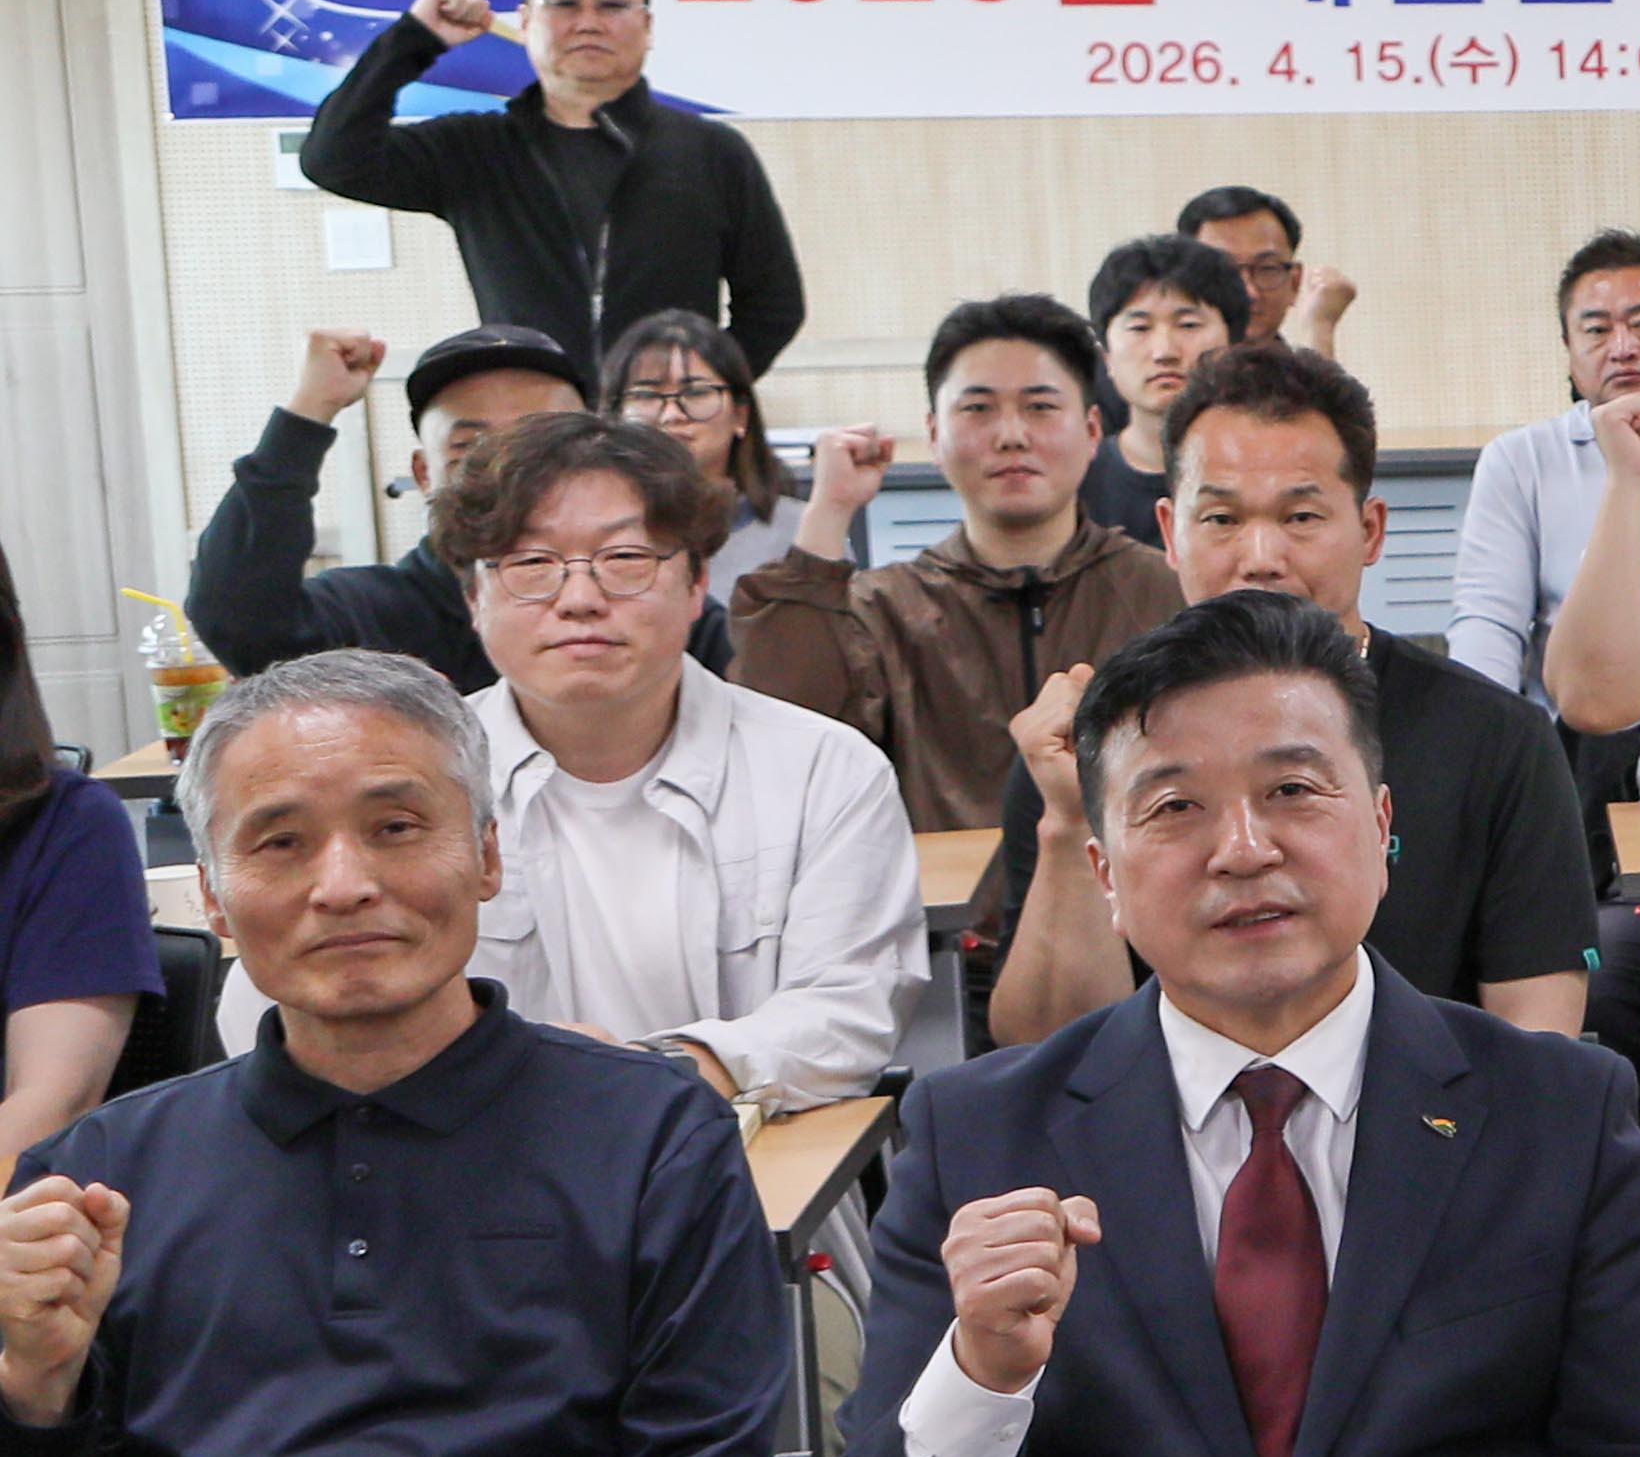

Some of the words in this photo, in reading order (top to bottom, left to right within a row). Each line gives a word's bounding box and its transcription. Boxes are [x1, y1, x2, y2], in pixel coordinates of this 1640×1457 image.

[1088, 41, 1238, 86] 2026.
[1268, 42, 1313, 85] 4.
[1346, 35, 1519, 86] 15.(수)
